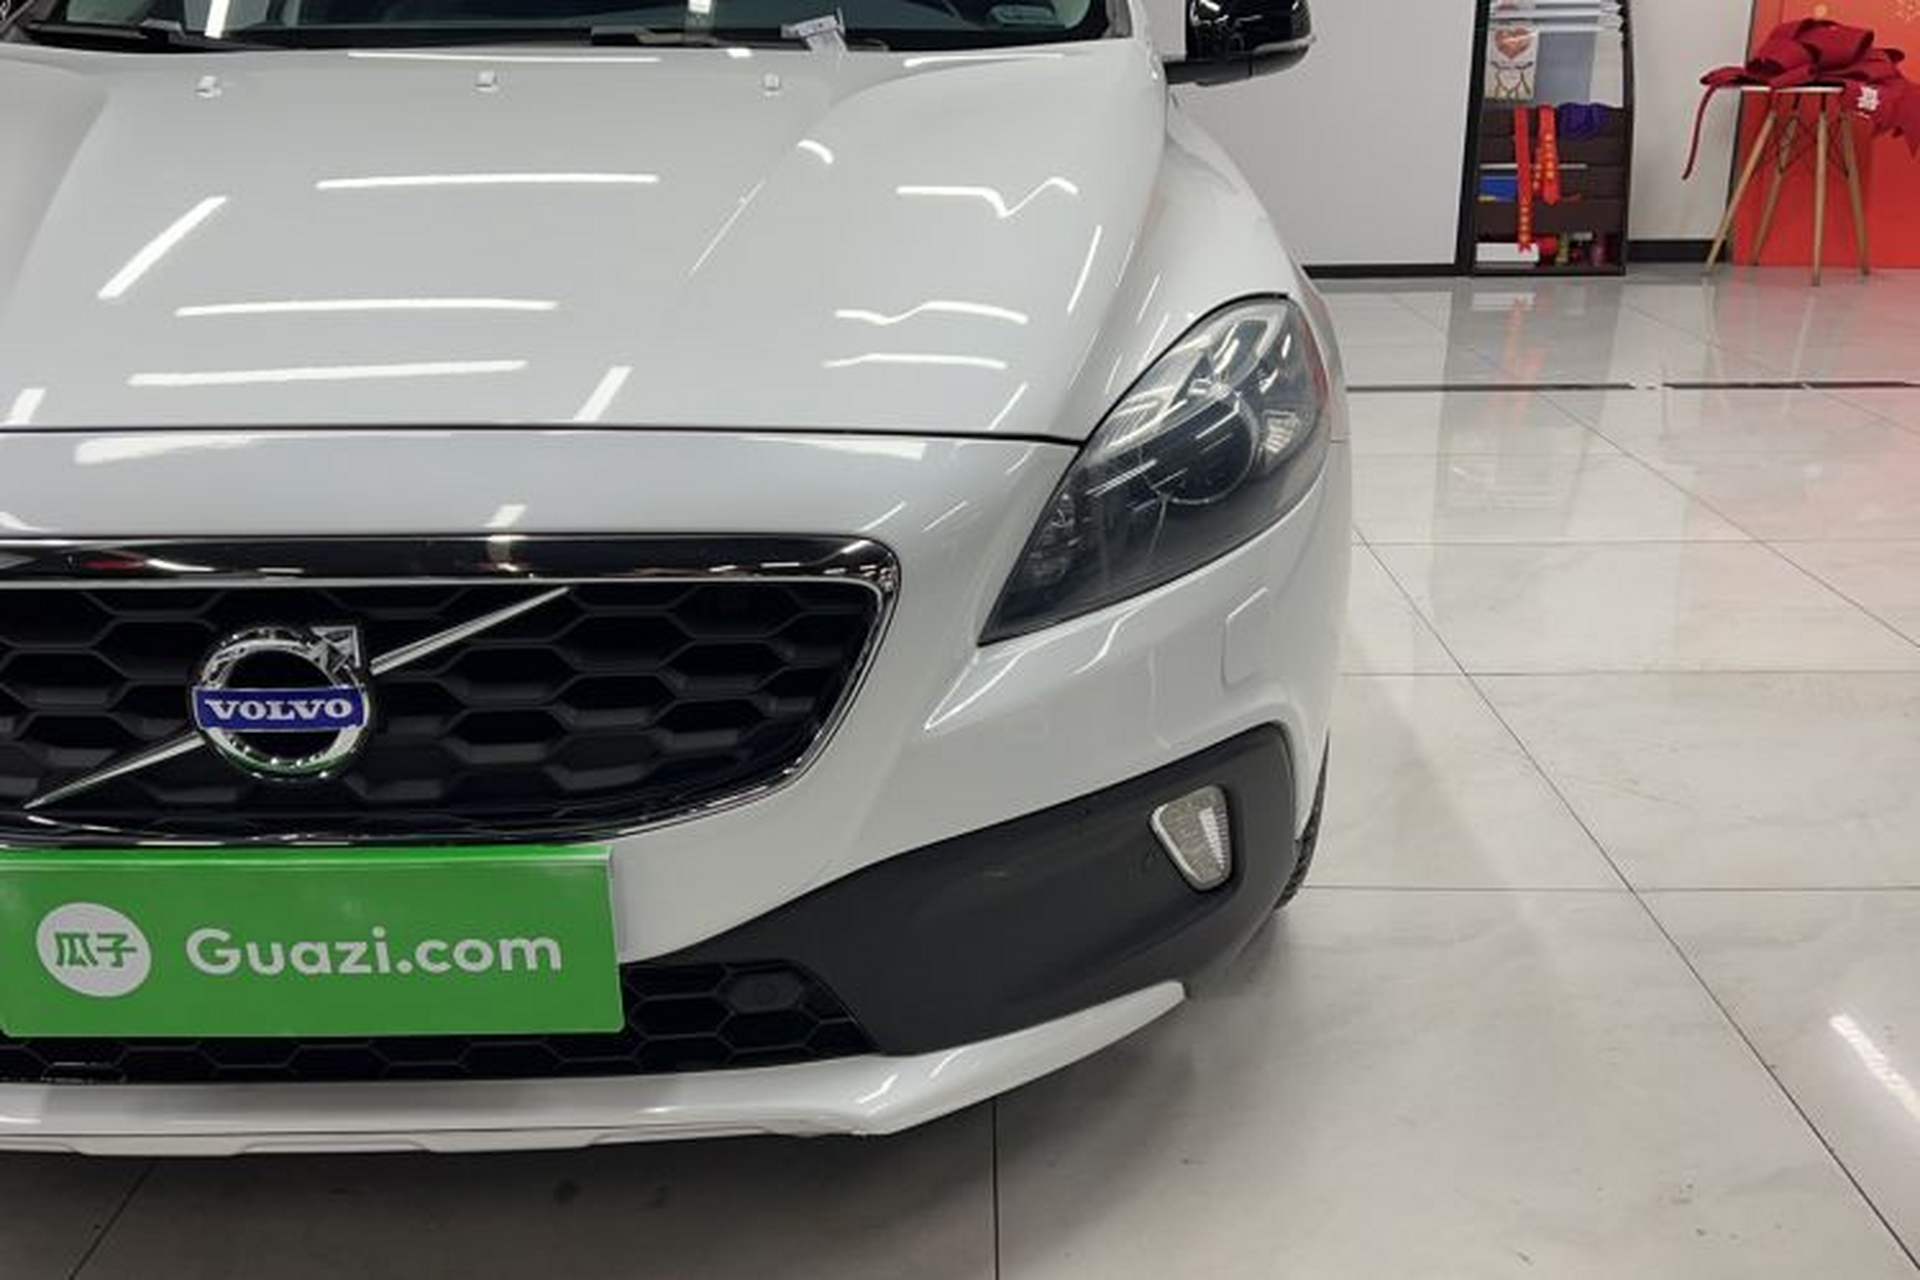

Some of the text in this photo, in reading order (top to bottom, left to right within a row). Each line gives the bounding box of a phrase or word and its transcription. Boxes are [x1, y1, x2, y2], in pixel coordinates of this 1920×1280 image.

[204, 699, 353, 721] VOLVO
[54, 931, 138, 970] 瓜子
[186, 926, 562, 976] Guazi.com
